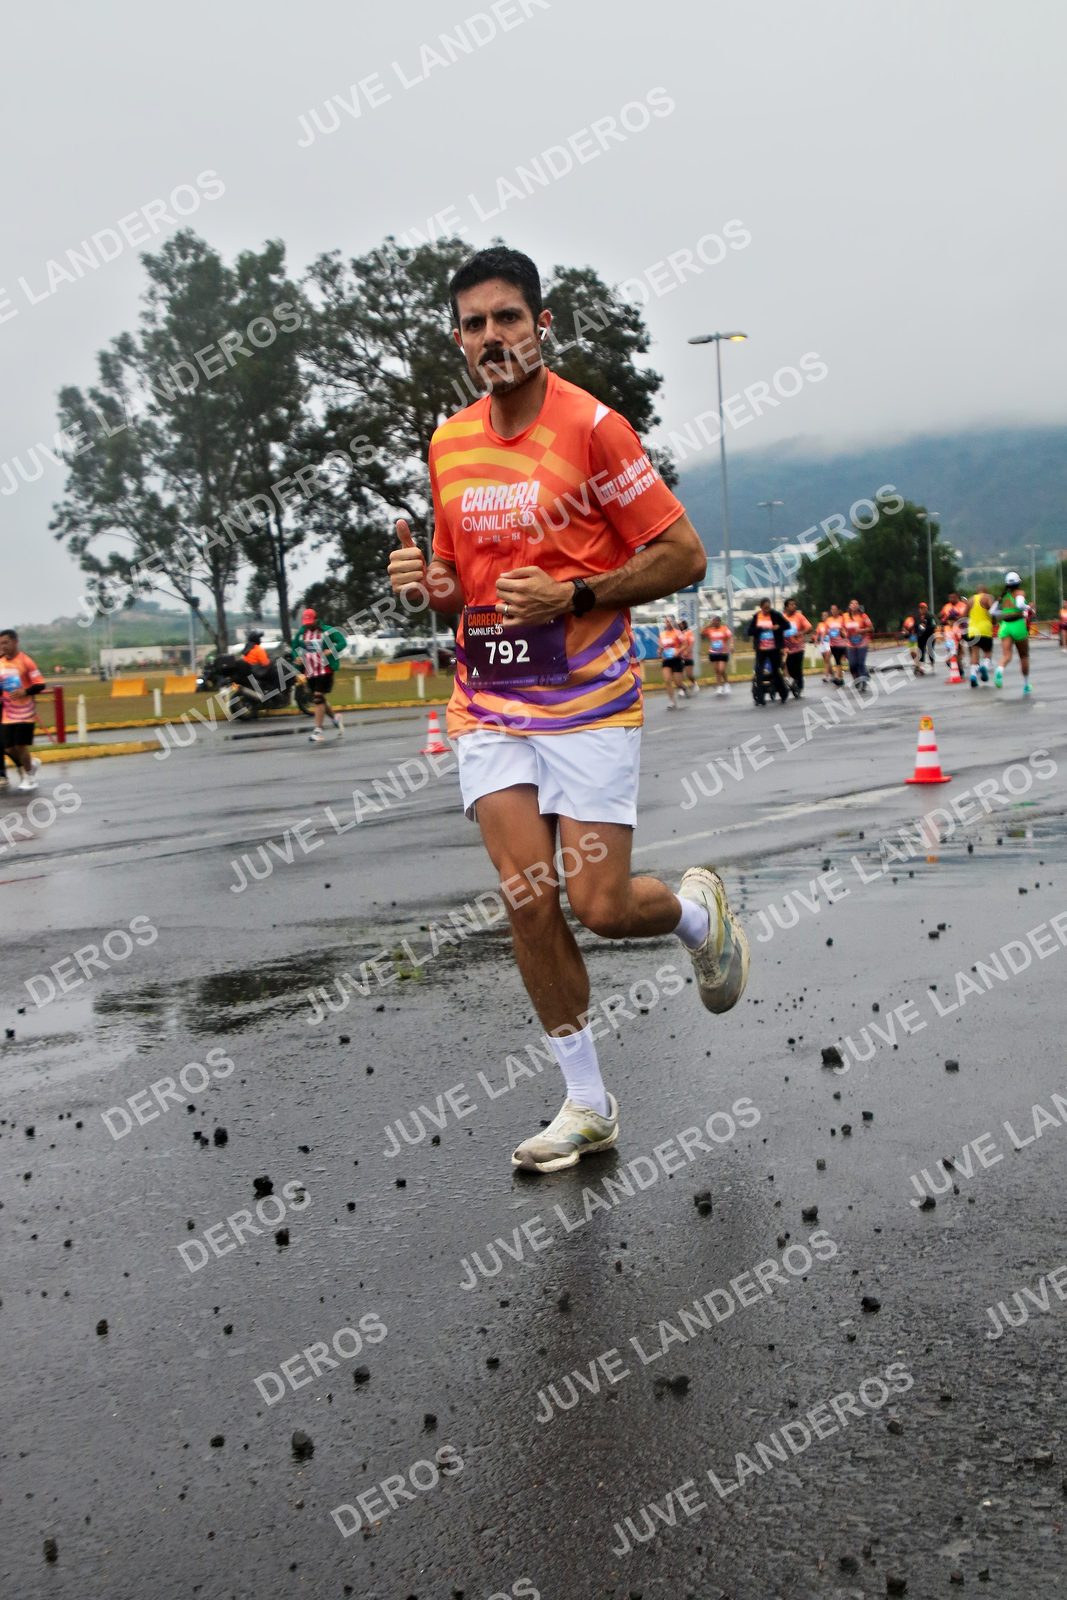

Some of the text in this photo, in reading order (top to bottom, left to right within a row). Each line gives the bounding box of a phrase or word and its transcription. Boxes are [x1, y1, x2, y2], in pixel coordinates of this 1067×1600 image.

[461, 480, 540, 512] CARRERA
[462, 512, 518, 532] OMNILIFE
[467, 611, 503, 627] CARRERA
[468, 626, 494, 636] OMNILIFE
[485, 639, 530, 664] 792
